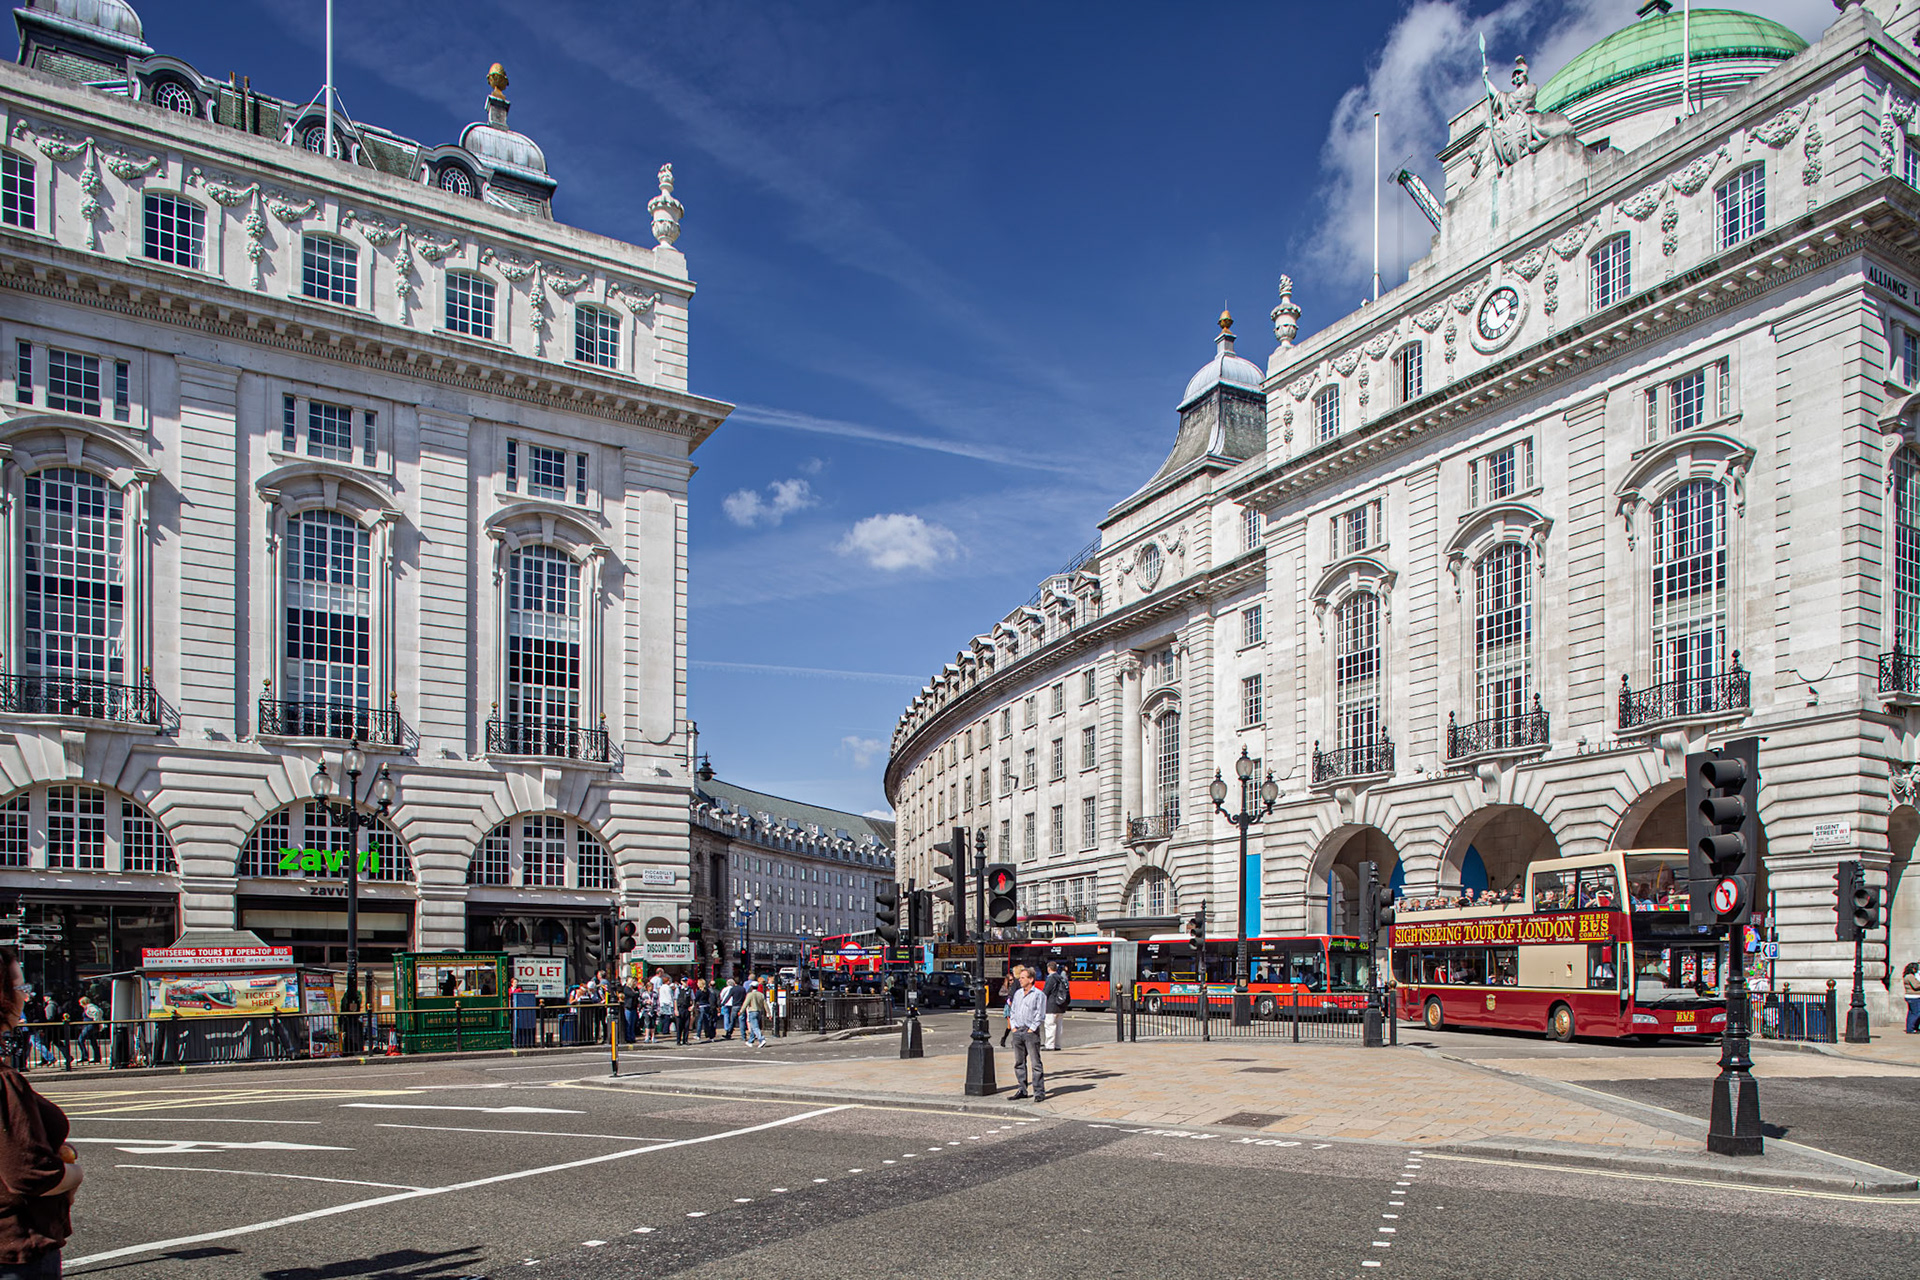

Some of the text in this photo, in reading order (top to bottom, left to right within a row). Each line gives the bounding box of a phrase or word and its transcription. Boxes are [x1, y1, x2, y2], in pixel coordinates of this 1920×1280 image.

[1868, 266, 1908, 300] ALLIANCE
[1815, 829, 1838, 837] STREET
[310, 884, 349, 897] zavvi
[647, 925, 671, 934] zavvi
[1579, 919, 1609, 932] BUS
[1395, 921, 1575, 943] SIGHTSEEING TOUR OF LONDON
[147, 947, 288, 957] SIGHTSEEING TOURS BY OPEN-TOP BUS
[647, 943, 670, 953] DISCOUNT
[671, 943, 690, 953] TICKETS
[1770, 945, 1777, 956] P
[517, 966, 562, 977] TO LET
[244, 991, 281, 999] TICKETS
[252, 999, 274, 1007] HERE
